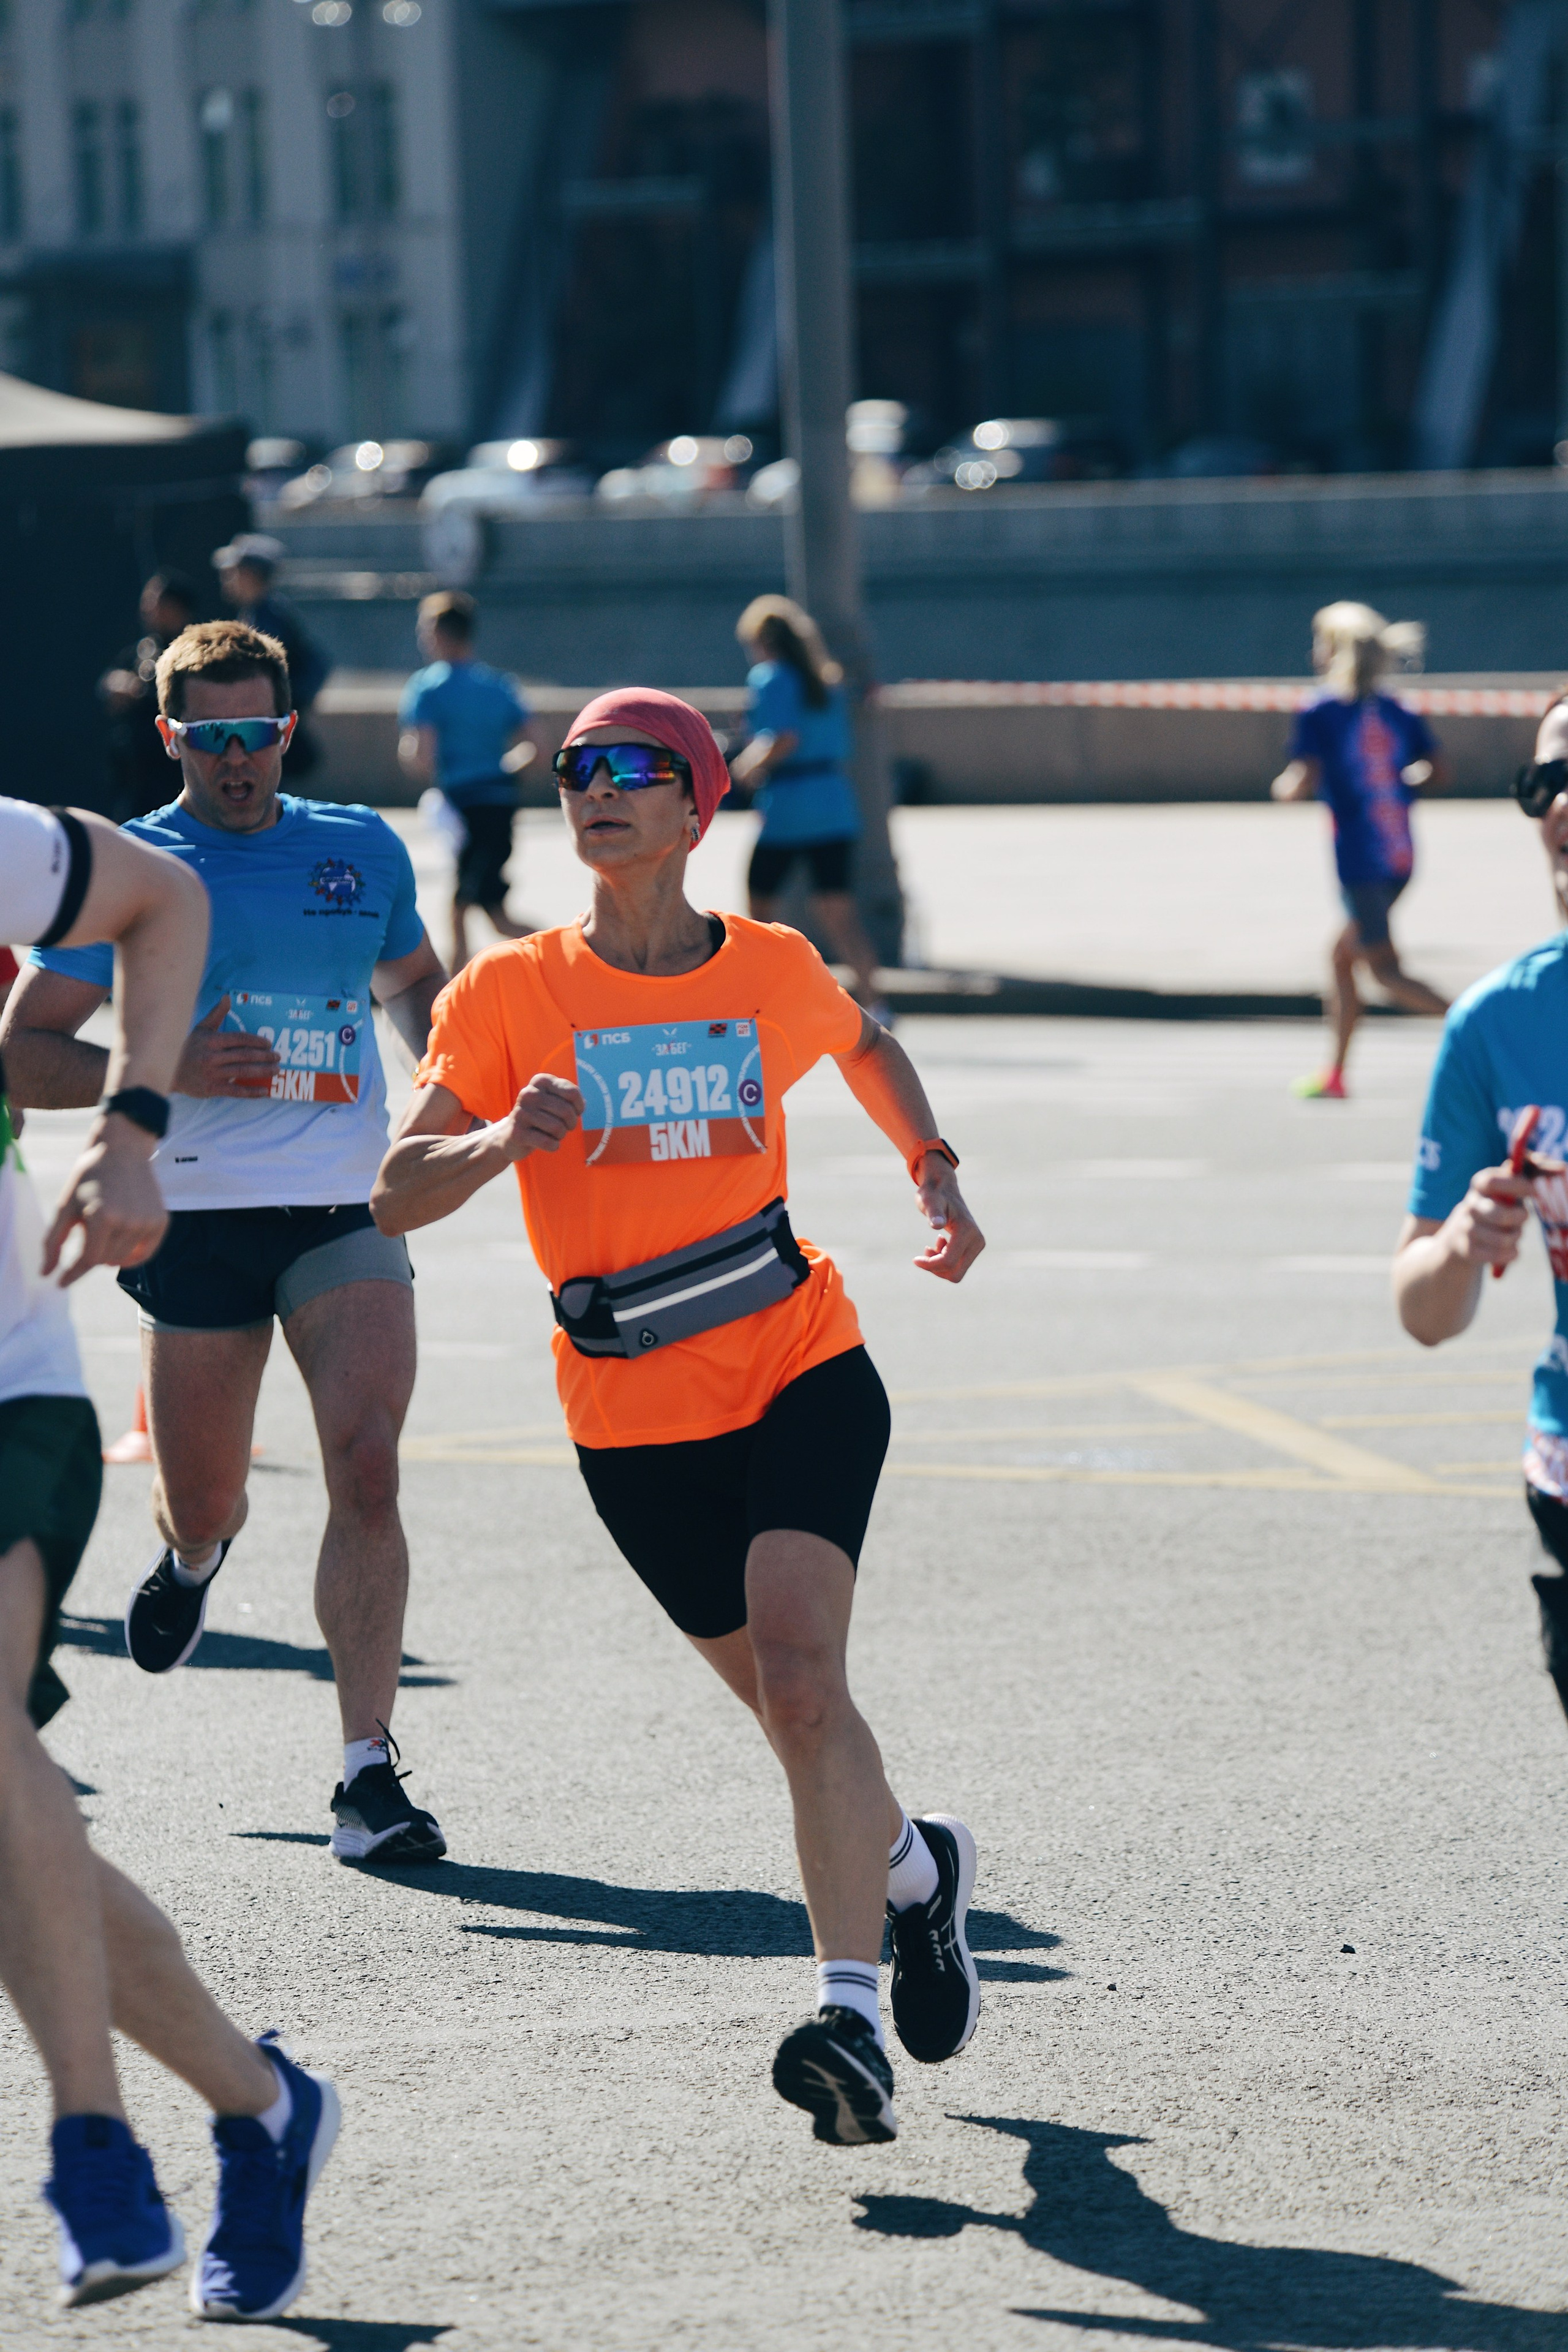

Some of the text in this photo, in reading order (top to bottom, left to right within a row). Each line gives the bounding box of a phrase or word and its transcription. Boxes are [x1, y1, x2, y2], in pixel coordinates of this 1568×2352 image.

[250, 995, 273, 1006] ПСБ
[341, 1027, 353, 1042] C
[601, 1033, 631, 1045] ПСБ
[618, 1064, 732, 1120] 24912
[743, 1084, 758, 1102] C
